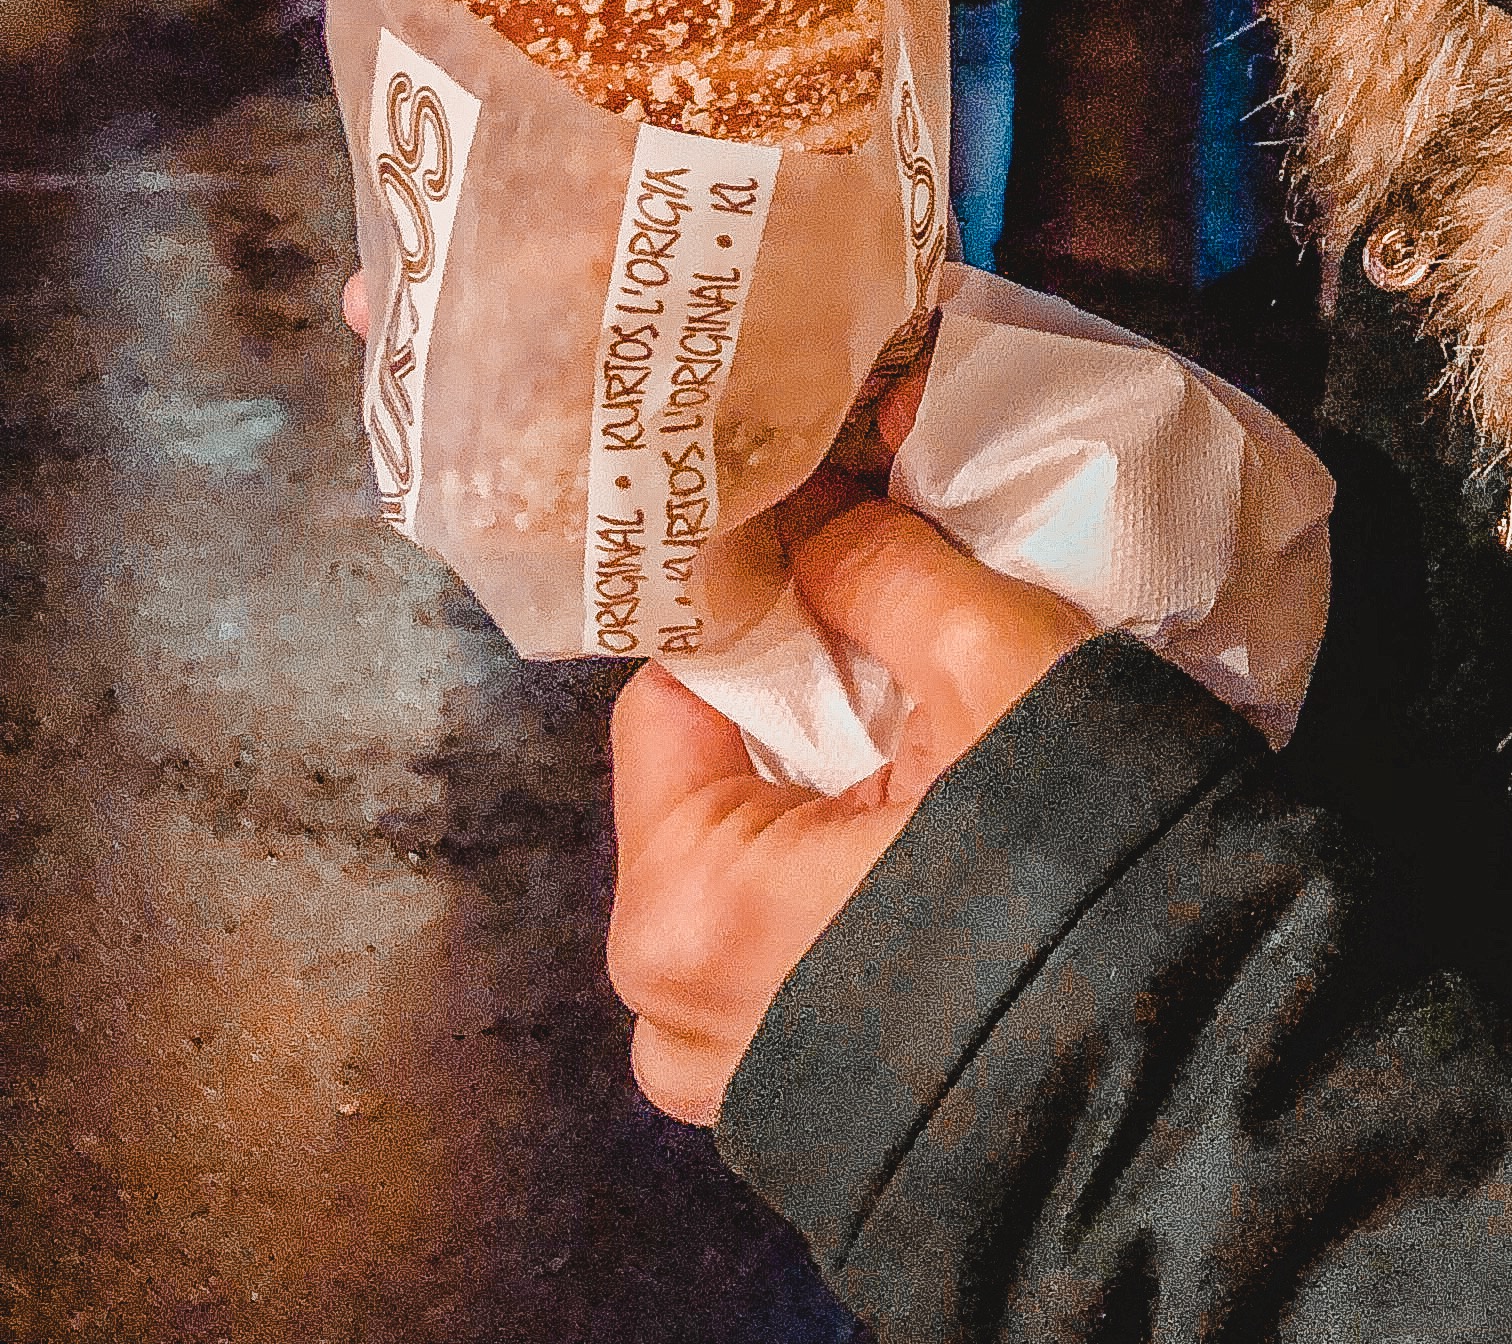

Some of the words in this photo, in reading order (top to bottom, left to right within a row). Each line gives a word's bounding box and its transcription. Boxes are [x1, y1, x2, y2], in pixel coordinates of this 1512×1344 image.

[600, 323, 660, 451] KURTOS
[658, 267, 742, 433] L'ORIGINAL
[594, 508, 649, 655] ORIGINAL
